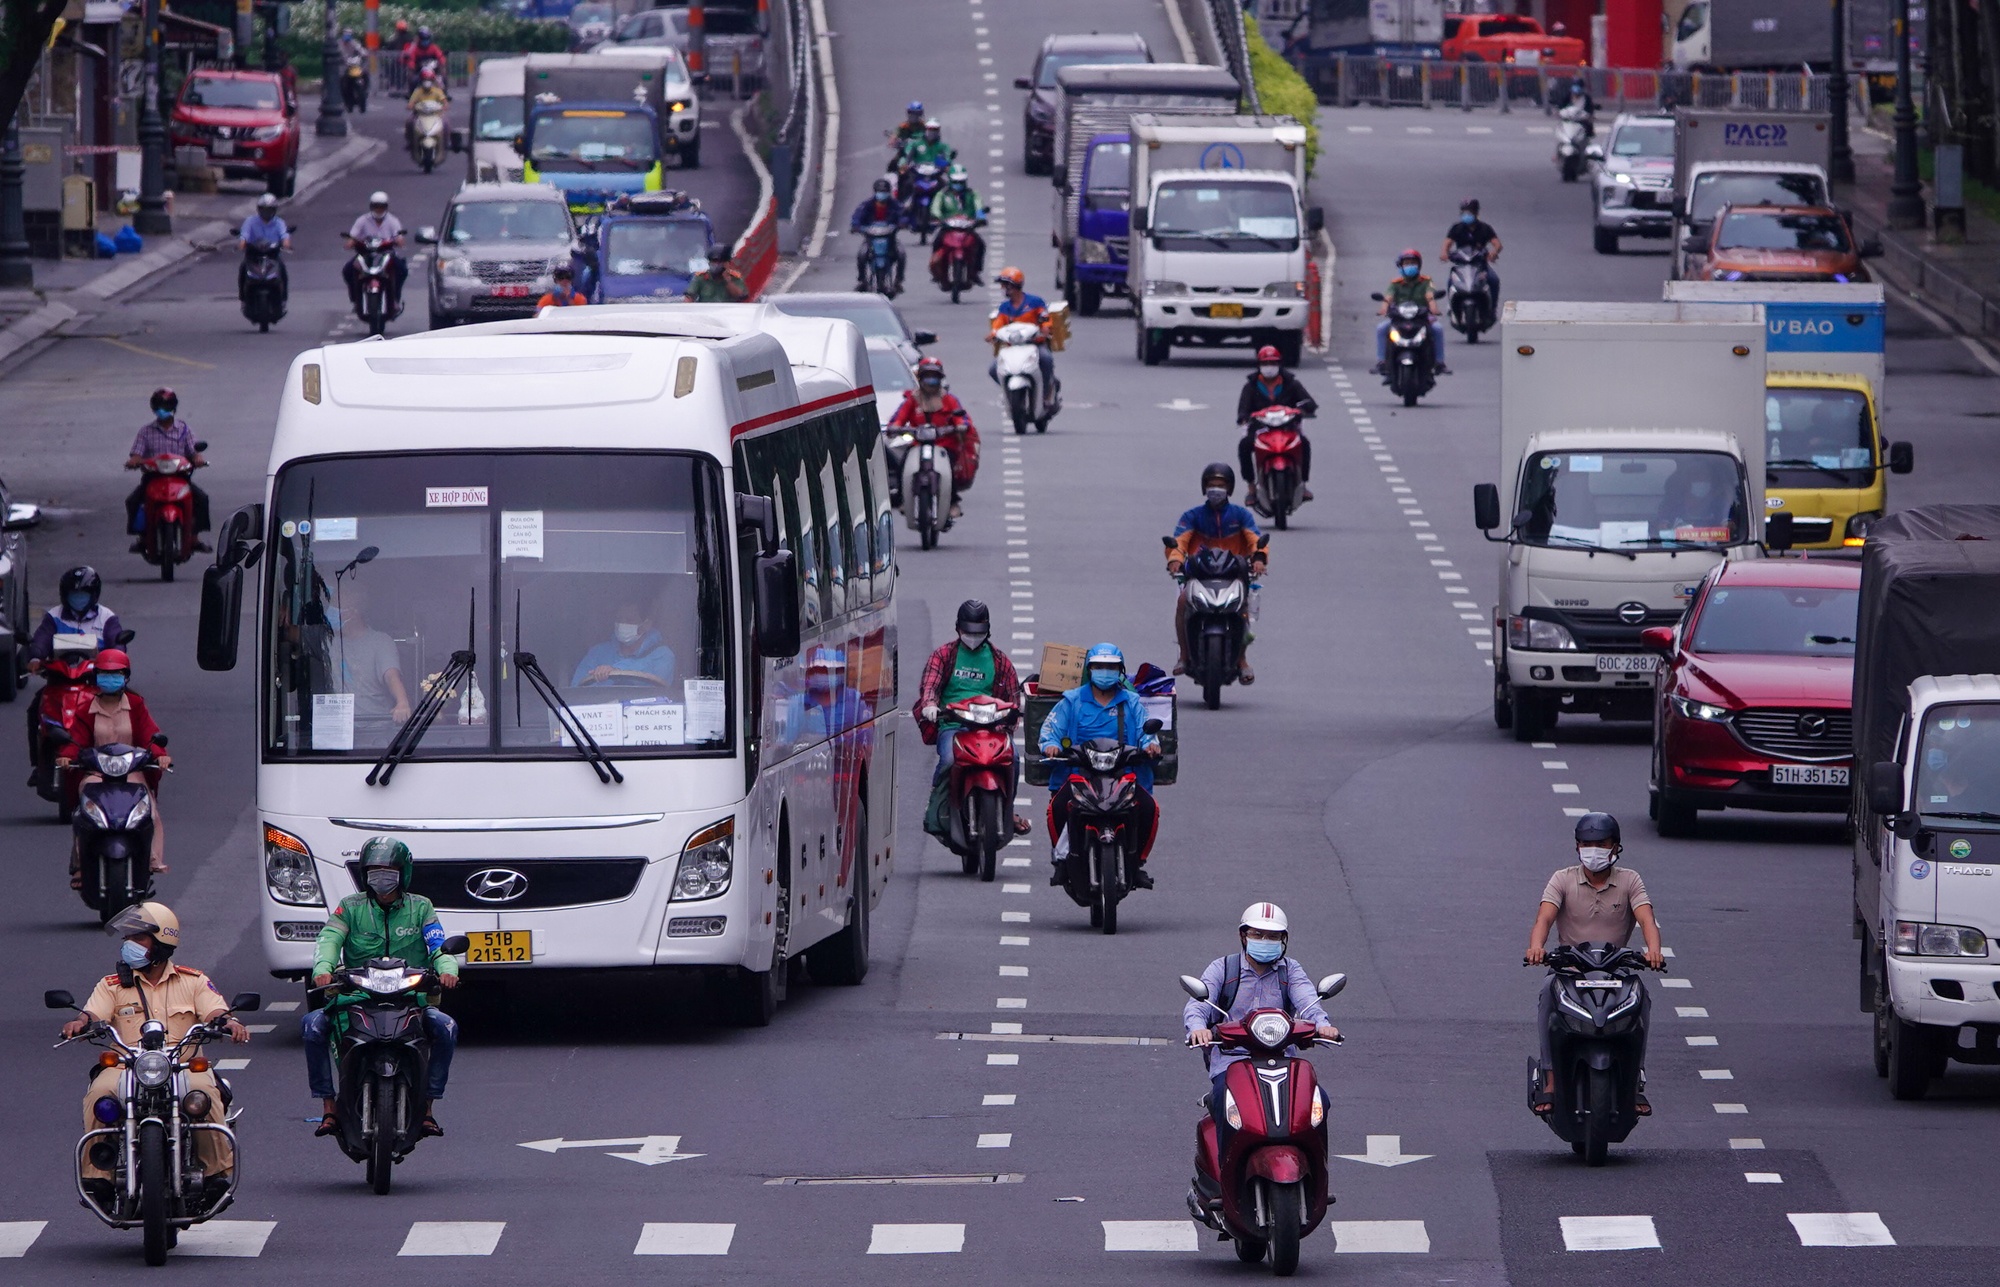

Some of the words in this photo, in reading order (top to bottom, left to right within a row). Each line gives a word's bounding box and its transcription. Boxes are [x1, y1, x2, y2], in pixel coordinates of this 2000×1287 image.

[428, 491, 440, 503] XE
[442, 490, 460, 505] HỢP
[462, 488, 486, 503] ĐỒNG
[1554, 598, 1589, 607] HINO
[1775, 768, 1847, 784] 51H-351.52
[370, 843, 389, 851] Grab
[1944, 865, 1993, 876] THACO
[395, 926, 420, 937] Grab
[484, 932, 513, 947] 51B
[473, 947, 525, 962] 215.12
